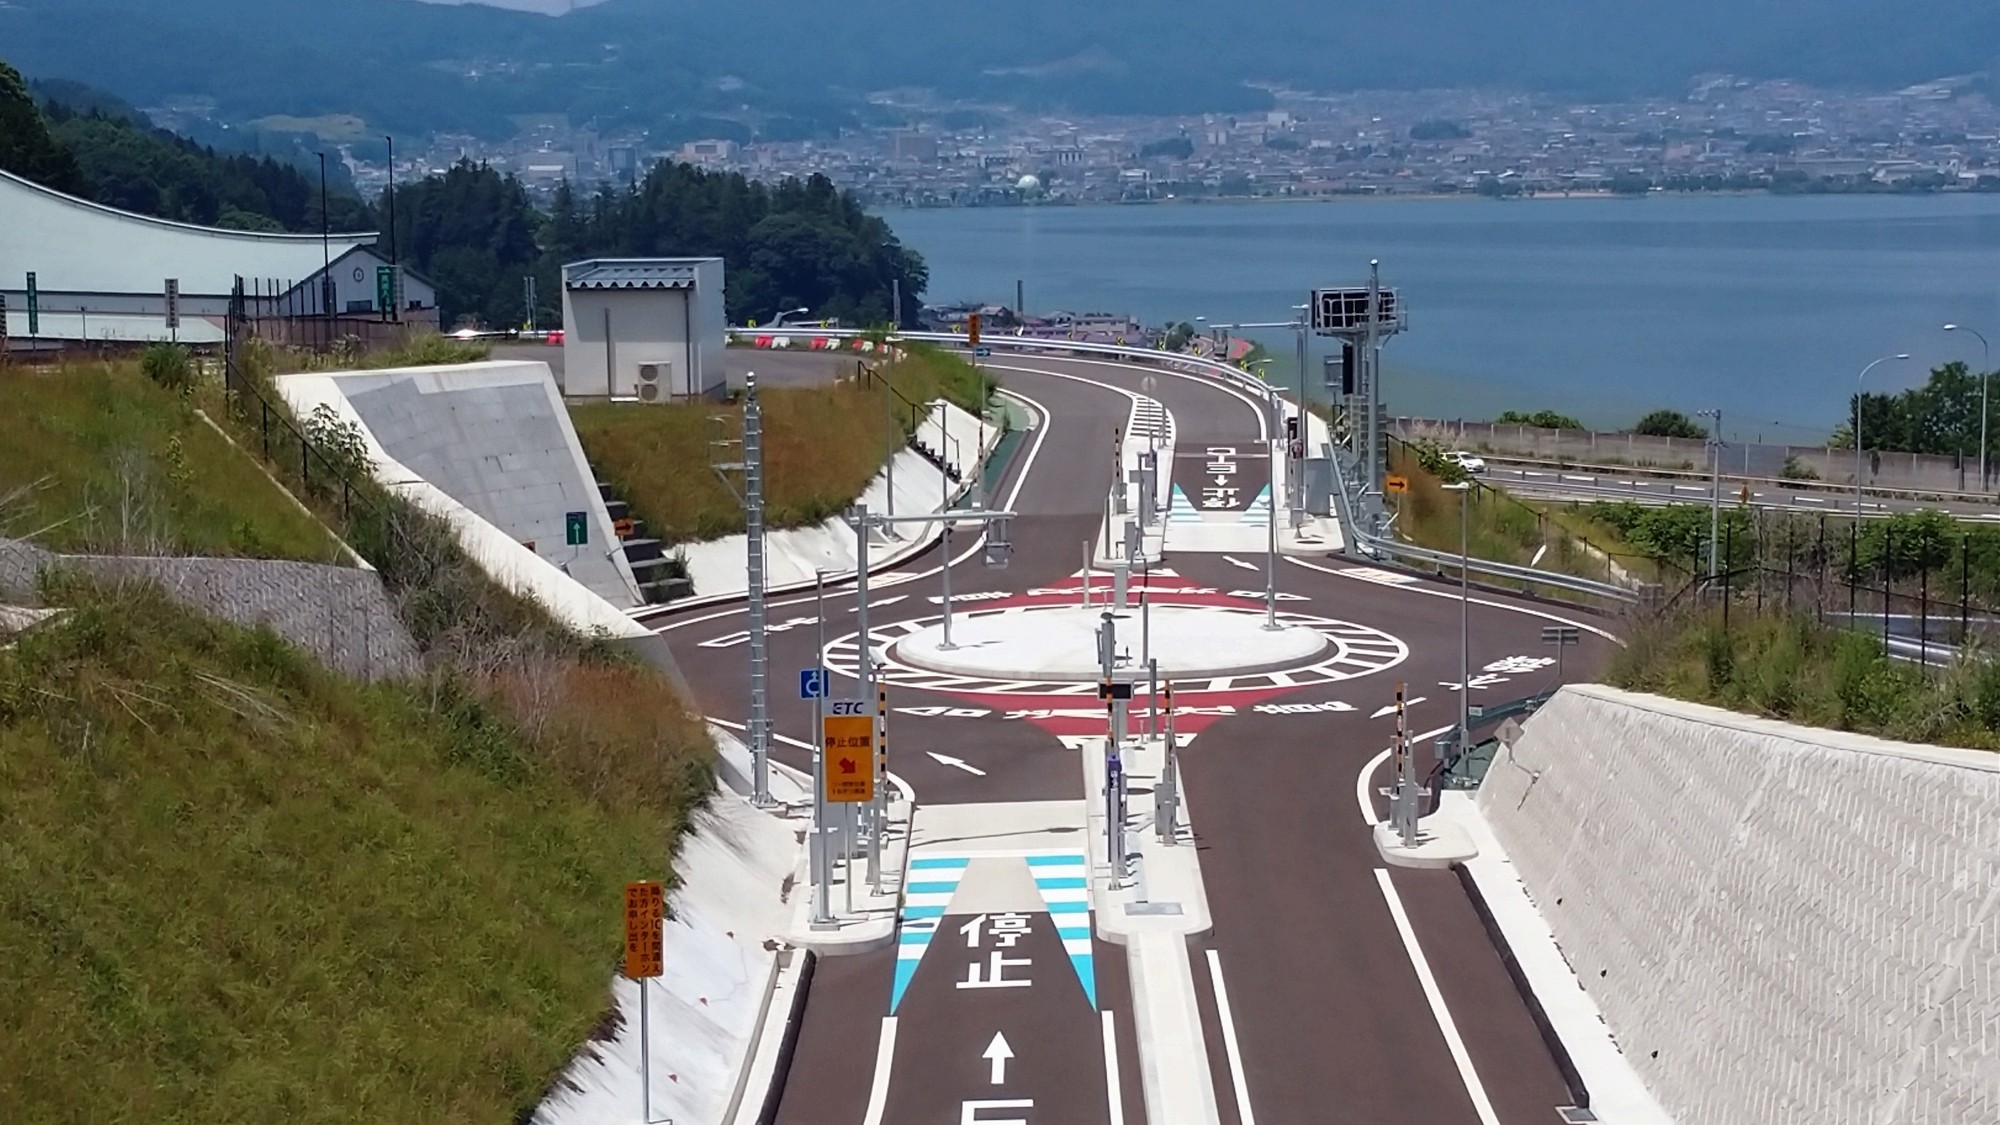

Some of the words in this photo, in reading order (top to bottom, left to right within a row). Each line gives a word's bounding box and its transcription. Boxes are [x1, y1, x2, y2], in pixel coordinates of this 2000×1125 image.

[1202, 487, 1240, 508] 停止
[832, 702, 864, 715] ETC
[825, 736, 870, 748] 停止位置
[628, 888, 638, 953] でお申し出を
[639, 887, 650, 975] た方インターホン
[956, 912, 1033, 989] 停止
